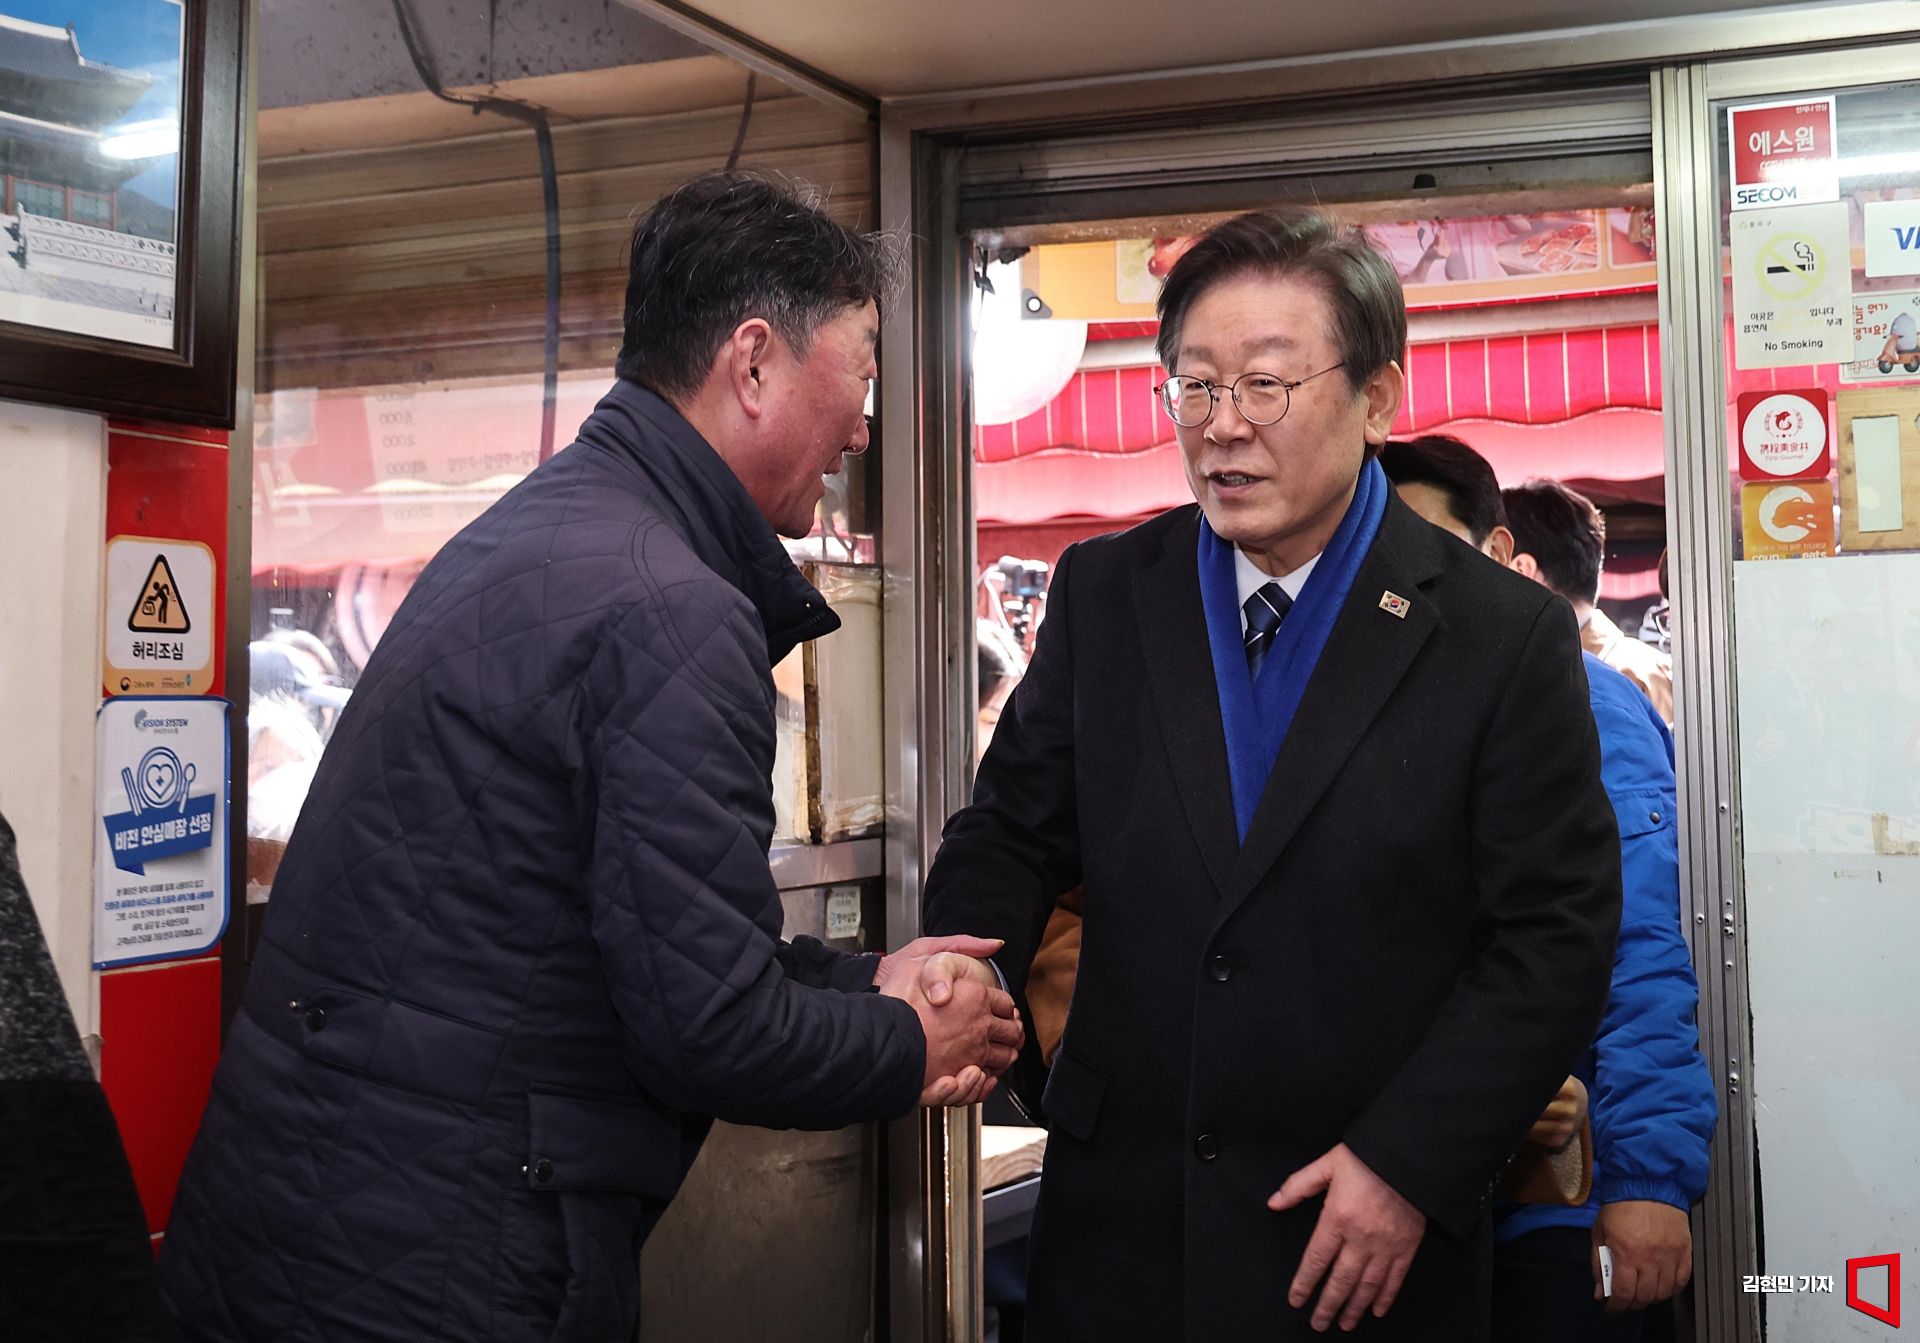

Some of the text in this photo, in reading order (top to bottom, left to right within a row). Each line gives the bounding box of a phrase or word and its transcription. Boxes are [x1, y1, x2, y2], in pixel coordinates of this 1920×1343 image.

[1749, 126, 1815, 155] 에스원
[1737, 186, 1797, 204] SECOM
[1764, 339, 1824, 351] No Smoking
[132, 641, 184, 661] 허리조심
[115, 812, 211, 850] 비전 안심매장 선정
